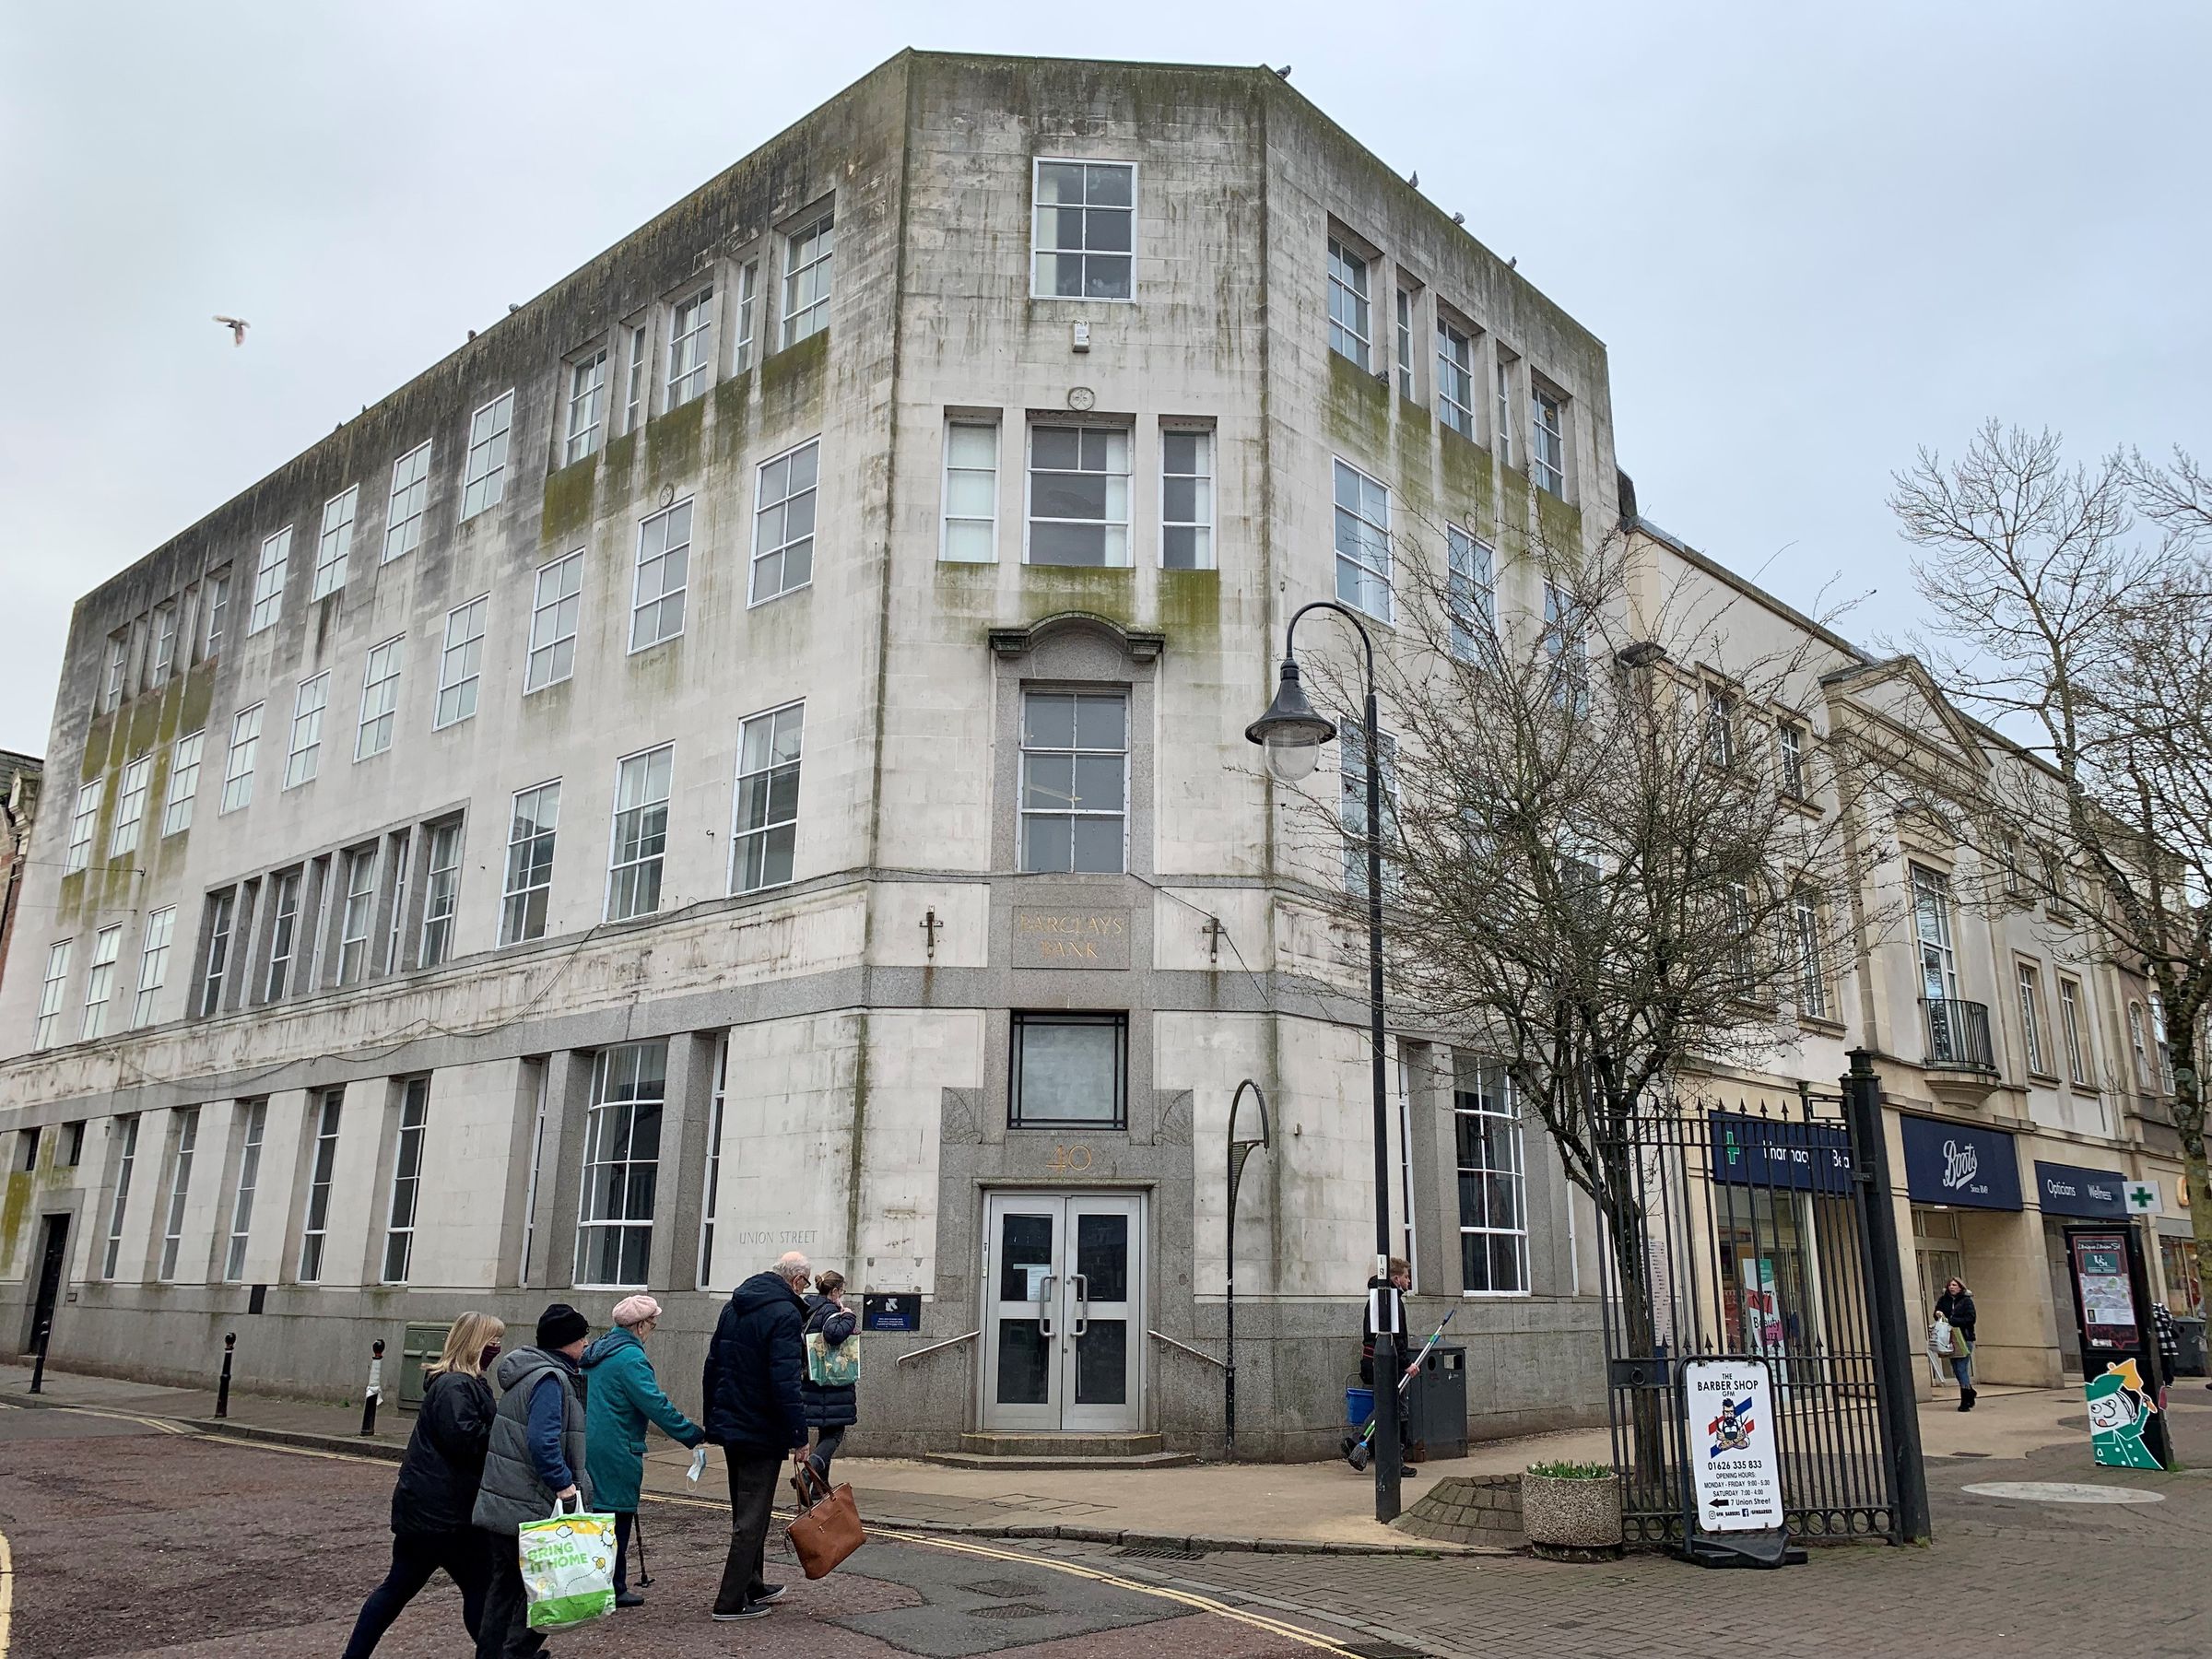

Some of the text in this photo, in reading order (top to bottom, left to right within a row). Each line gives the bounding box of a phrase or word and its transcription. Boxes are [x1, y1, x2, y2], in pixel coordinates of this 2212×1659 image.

[1019, 913, 1122, 935] BARCLAYS
[1041, 940, 1098, 959] BANK
[1046, 1145, 1091, 1173] 40
[1943, 1139, 1978, 1190] Boots
[2047, 1179, 2112, 1201] Opticians Wellness
[739, 1230, 818, 1244] UNION STREET
[1752, 1290, 1771, 1315] N7
[1754, 1317, 1780, 1331] Bauty
[1697, 1380, 1759, 1391] BARBER SHOP
[1708, 1460, 1762, 1470] 01626 335 833
[527, 1541, 573, 1560] BRING
[530, 1553, 588, 1574] IT HOME
